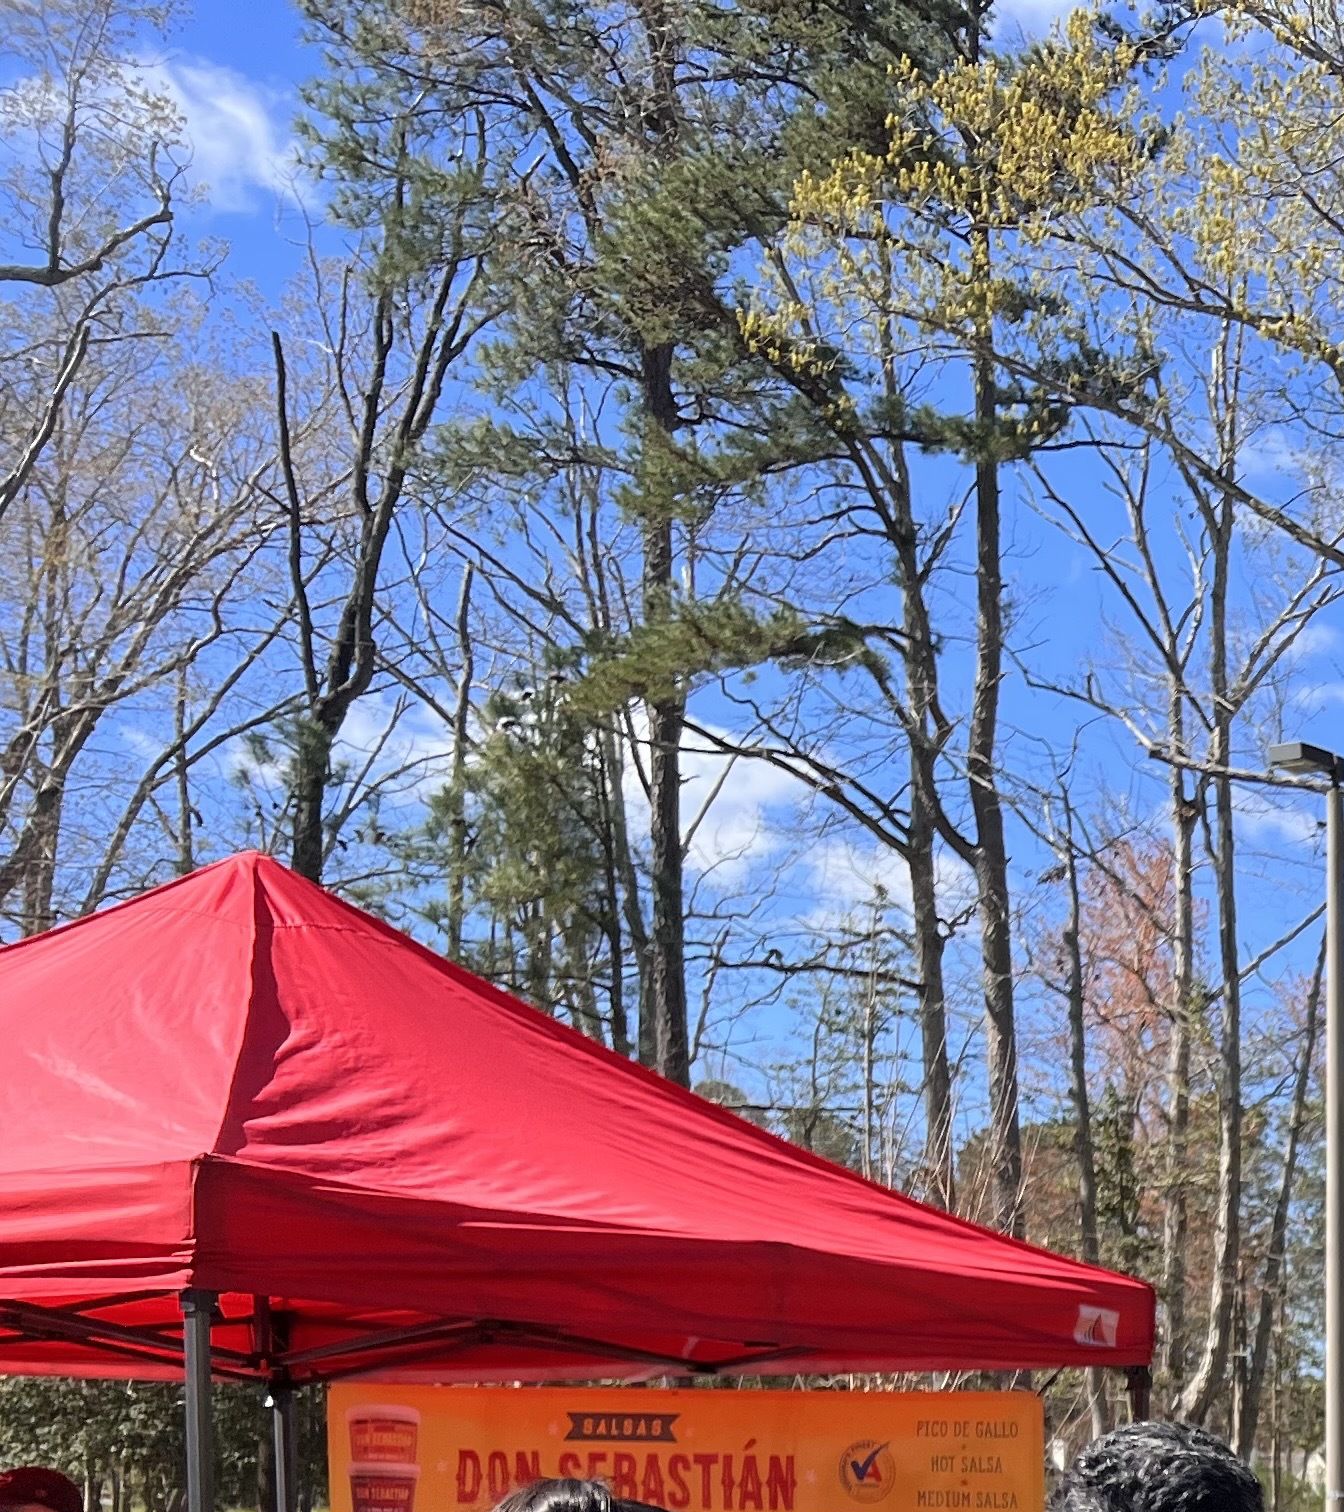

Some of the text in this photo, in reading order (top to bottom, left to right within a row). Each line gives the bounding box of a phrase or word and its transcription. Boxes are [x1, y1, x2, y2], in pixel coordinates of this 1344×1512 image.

[583, 1418, 662, 1436] SALSAS
[916, 1420, 1019, 1438] PICO DE GALLO
[931, 1456, 1003, 1473] HOT SALSA
[456, 1449, 540, 1504] DON
[917, 1491, 1019, 1509] MEDIUM SALSA
